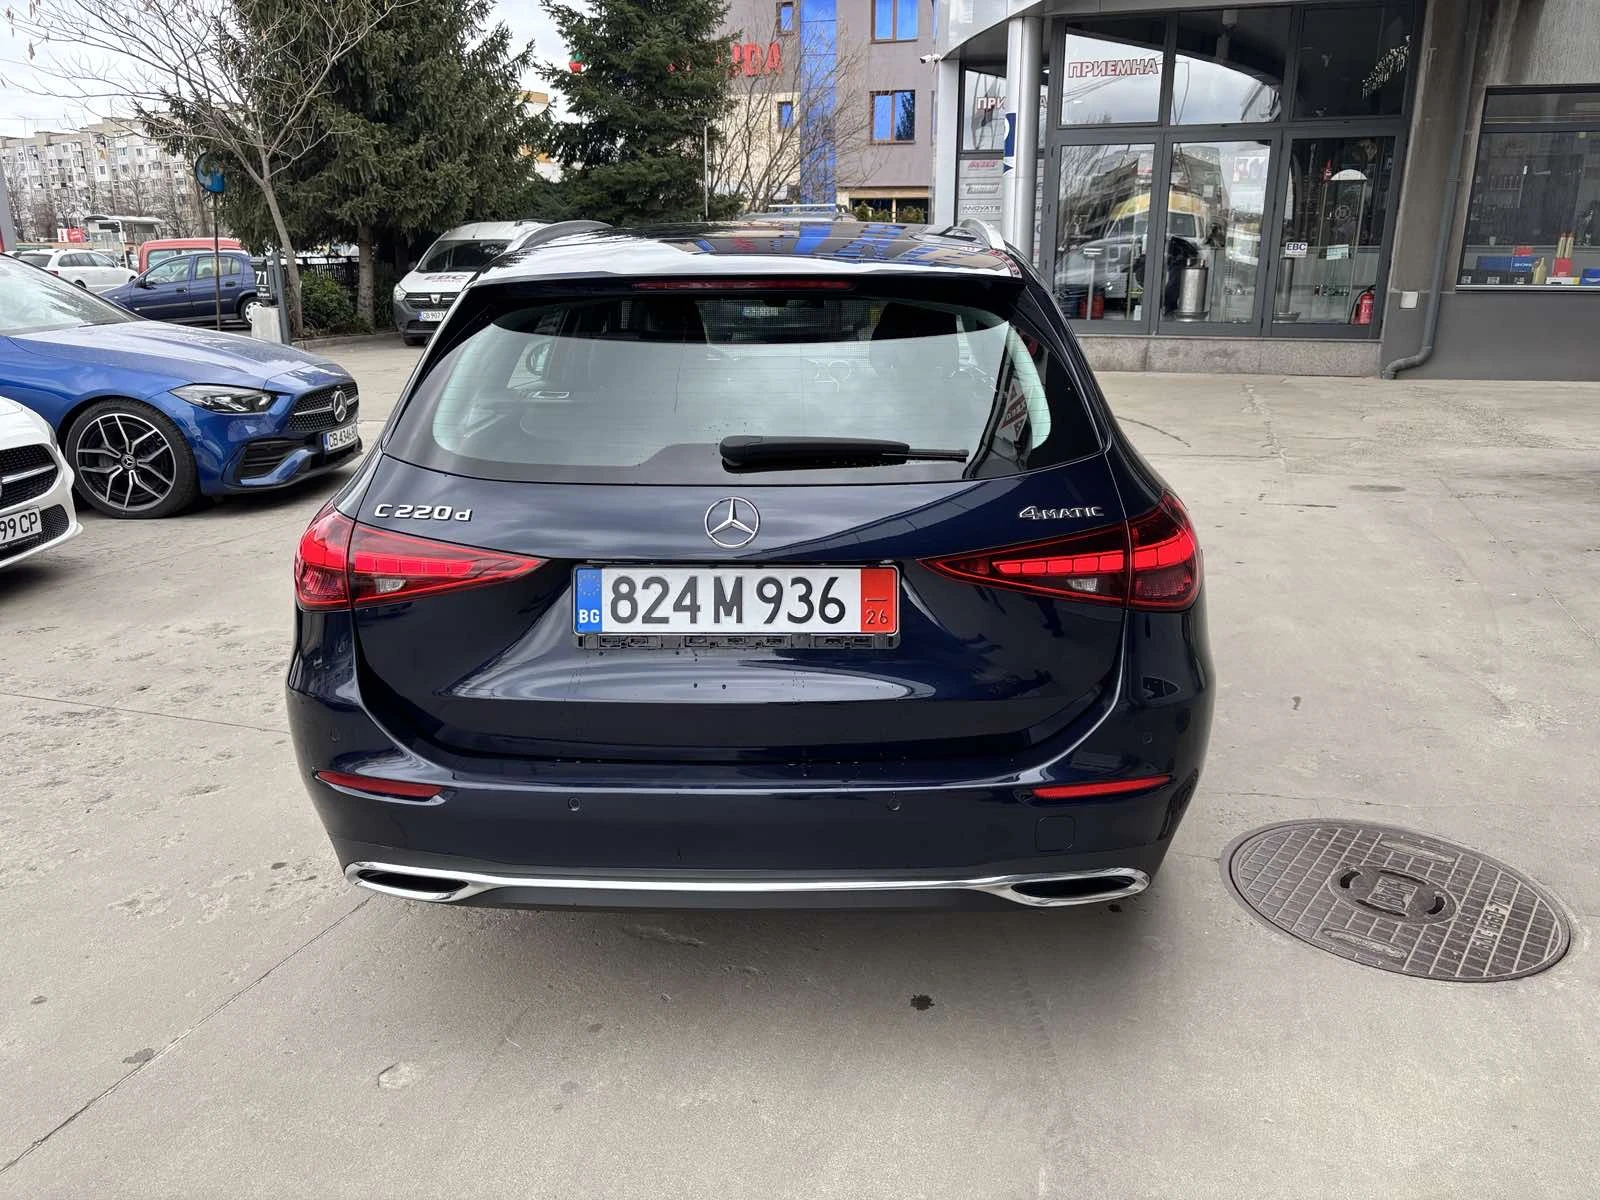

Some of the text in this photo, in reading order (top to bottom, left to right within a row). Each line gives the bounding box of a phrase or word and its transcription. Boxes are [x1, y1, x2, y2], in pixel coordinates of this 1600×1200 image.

[1068, 58, 1158, 78] ПРИЕМНА
[1286, 243, 1306, 251] EBC
[255, 270, 268, 285] 71
[1018, 505, 1105, 520] 4MATIC
[19, 511, 38, 534] CP
[579, 609, 600, 624] BG
[865, 608, 889, 625] 26
